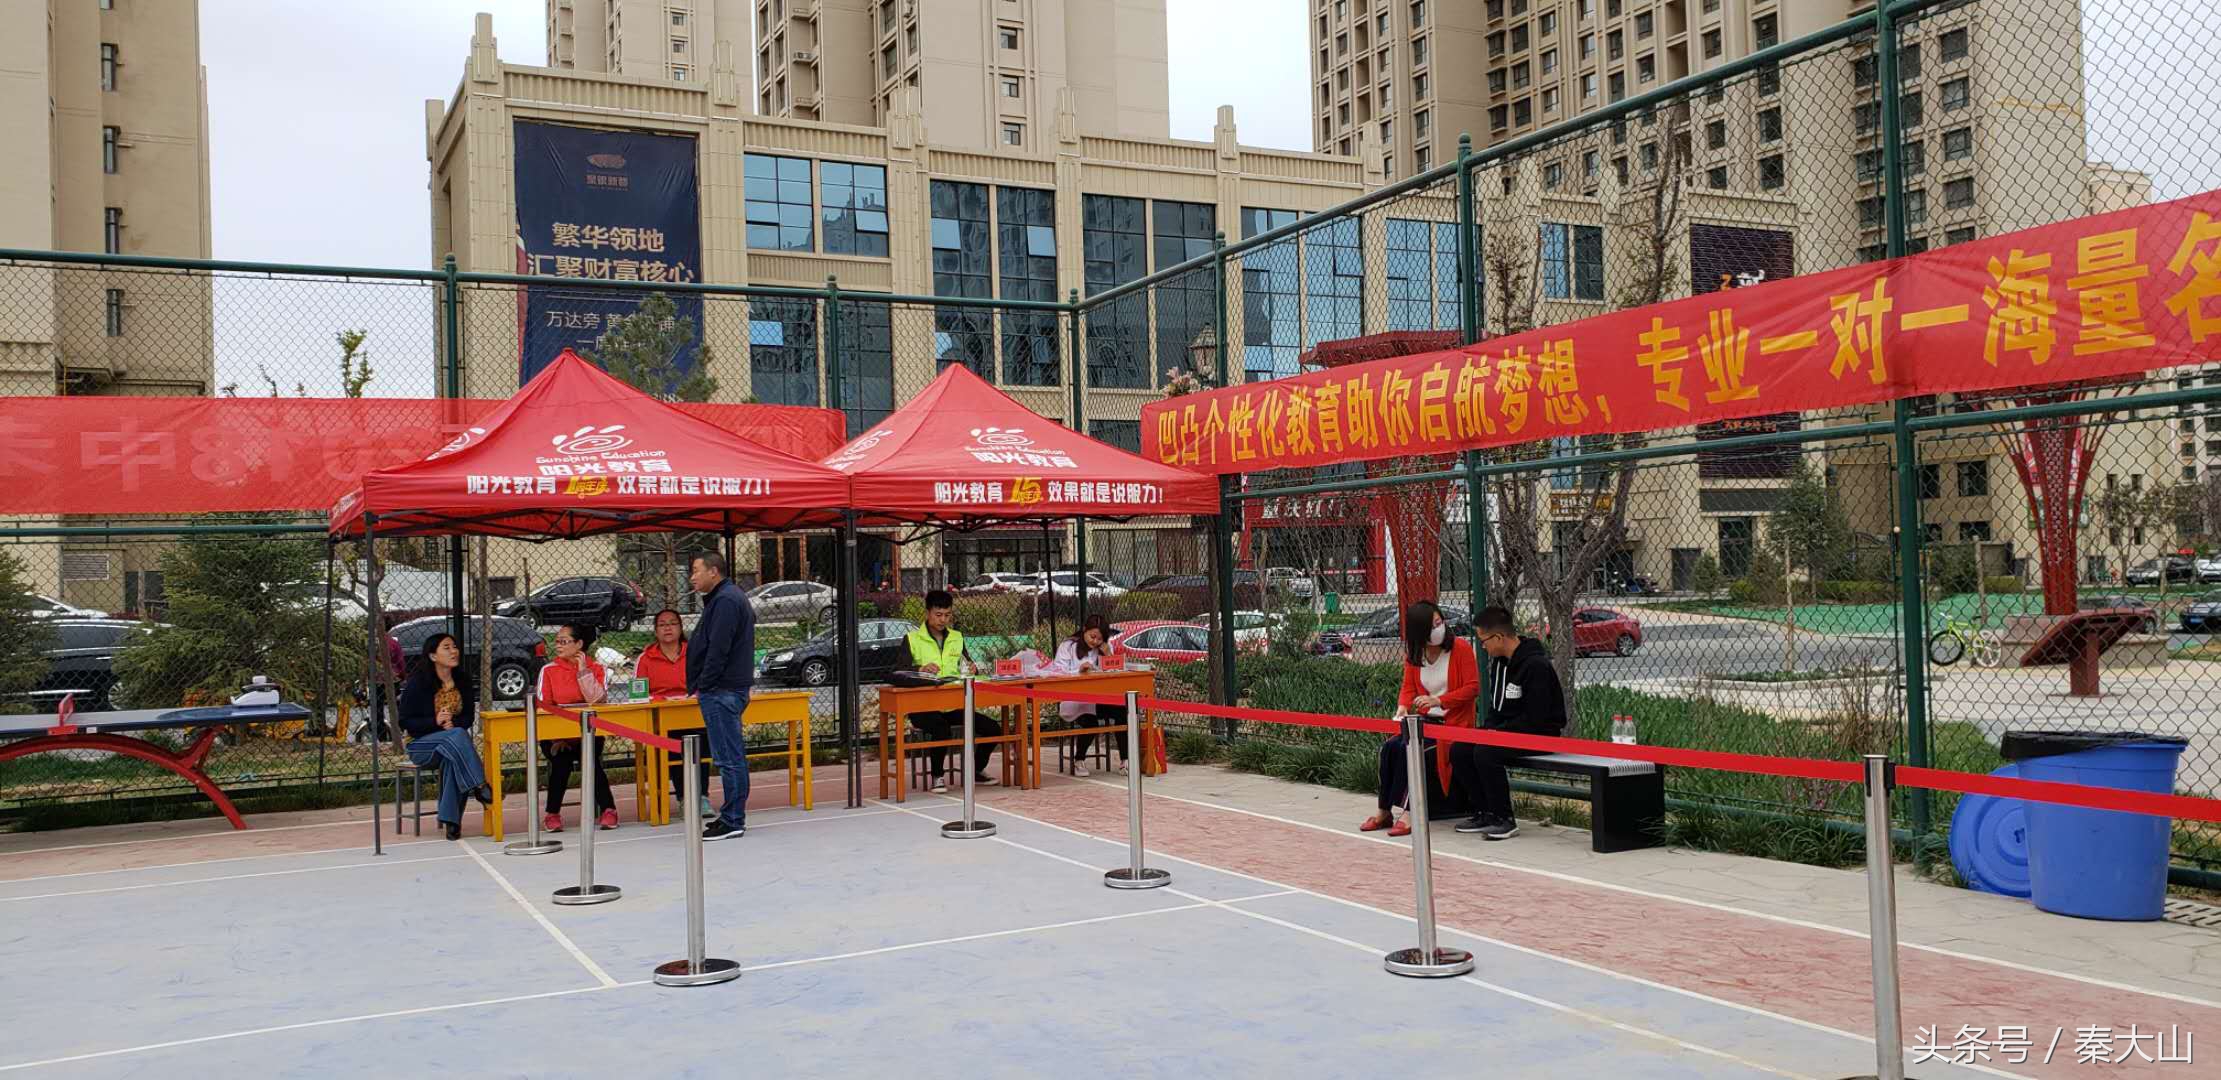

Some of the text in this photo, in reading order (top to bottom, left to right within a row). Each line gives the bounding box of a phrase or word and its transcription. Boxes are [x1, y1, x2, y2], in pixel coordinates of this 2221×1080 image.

[552, 221, 665, 253] 繁华领地
[527, 253, 694, 282] 汇聚财富核心
[546, 310, 601, 329] 万达旁
[601, 450, 666, 460] Education
[972, 452, 1078, 468] 阳光教育
[539, 459, 673, 476] 阳光教育
[467, 475, 556, 495] 阳光教育
[934, 482, 1003, 504] 阳光教育
